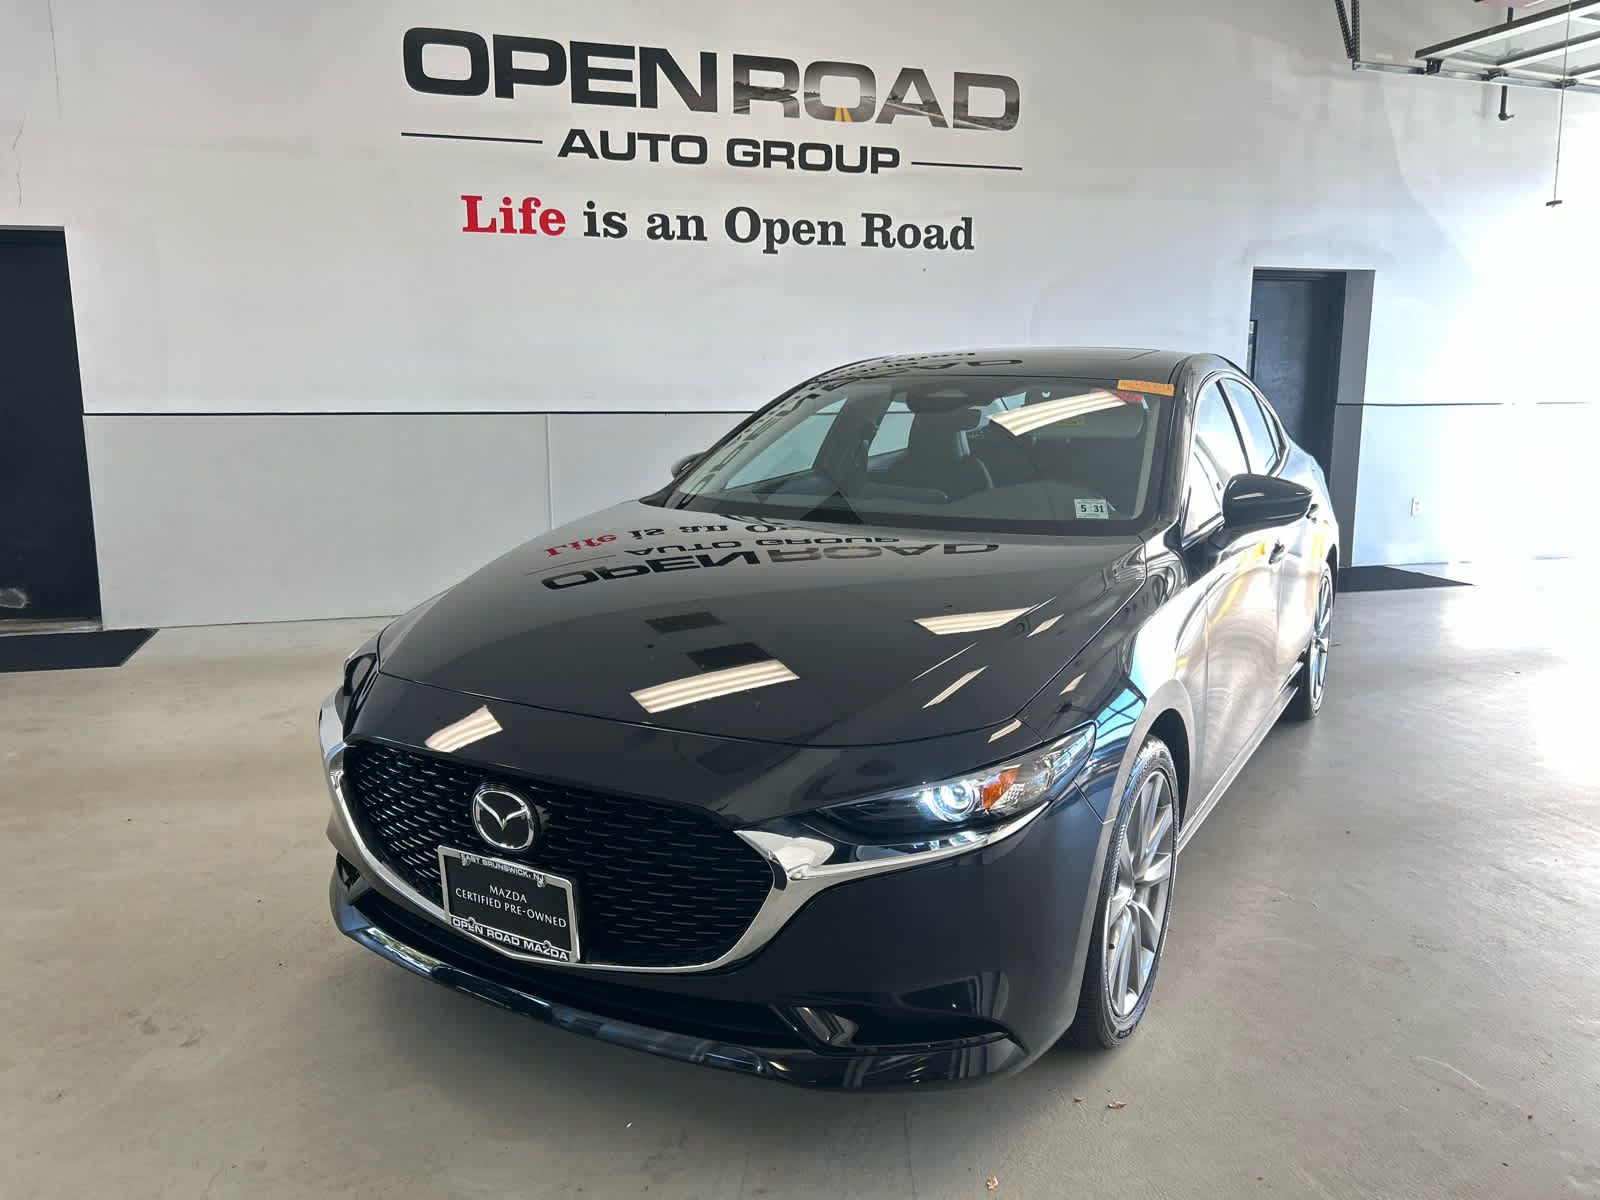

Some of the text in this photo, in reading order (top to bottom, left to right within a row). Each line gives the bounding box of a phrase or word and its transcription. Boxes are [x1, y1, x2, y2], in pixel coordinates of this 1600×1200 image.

[403, 27, 1021, 132] OPEN ROAD
[557, 128, 900, 174] AUTO GROUP
[461, 194, 975, 255] Life is an Open Road
[1080, 504, 1087, 513] 5
[455, 887, 567, 928] CERTIFIED PRE-OWNED
[489, 884, 527, 904] MAZDA
[452, 918, 569, 961] OPEN ROAD MAZDA
